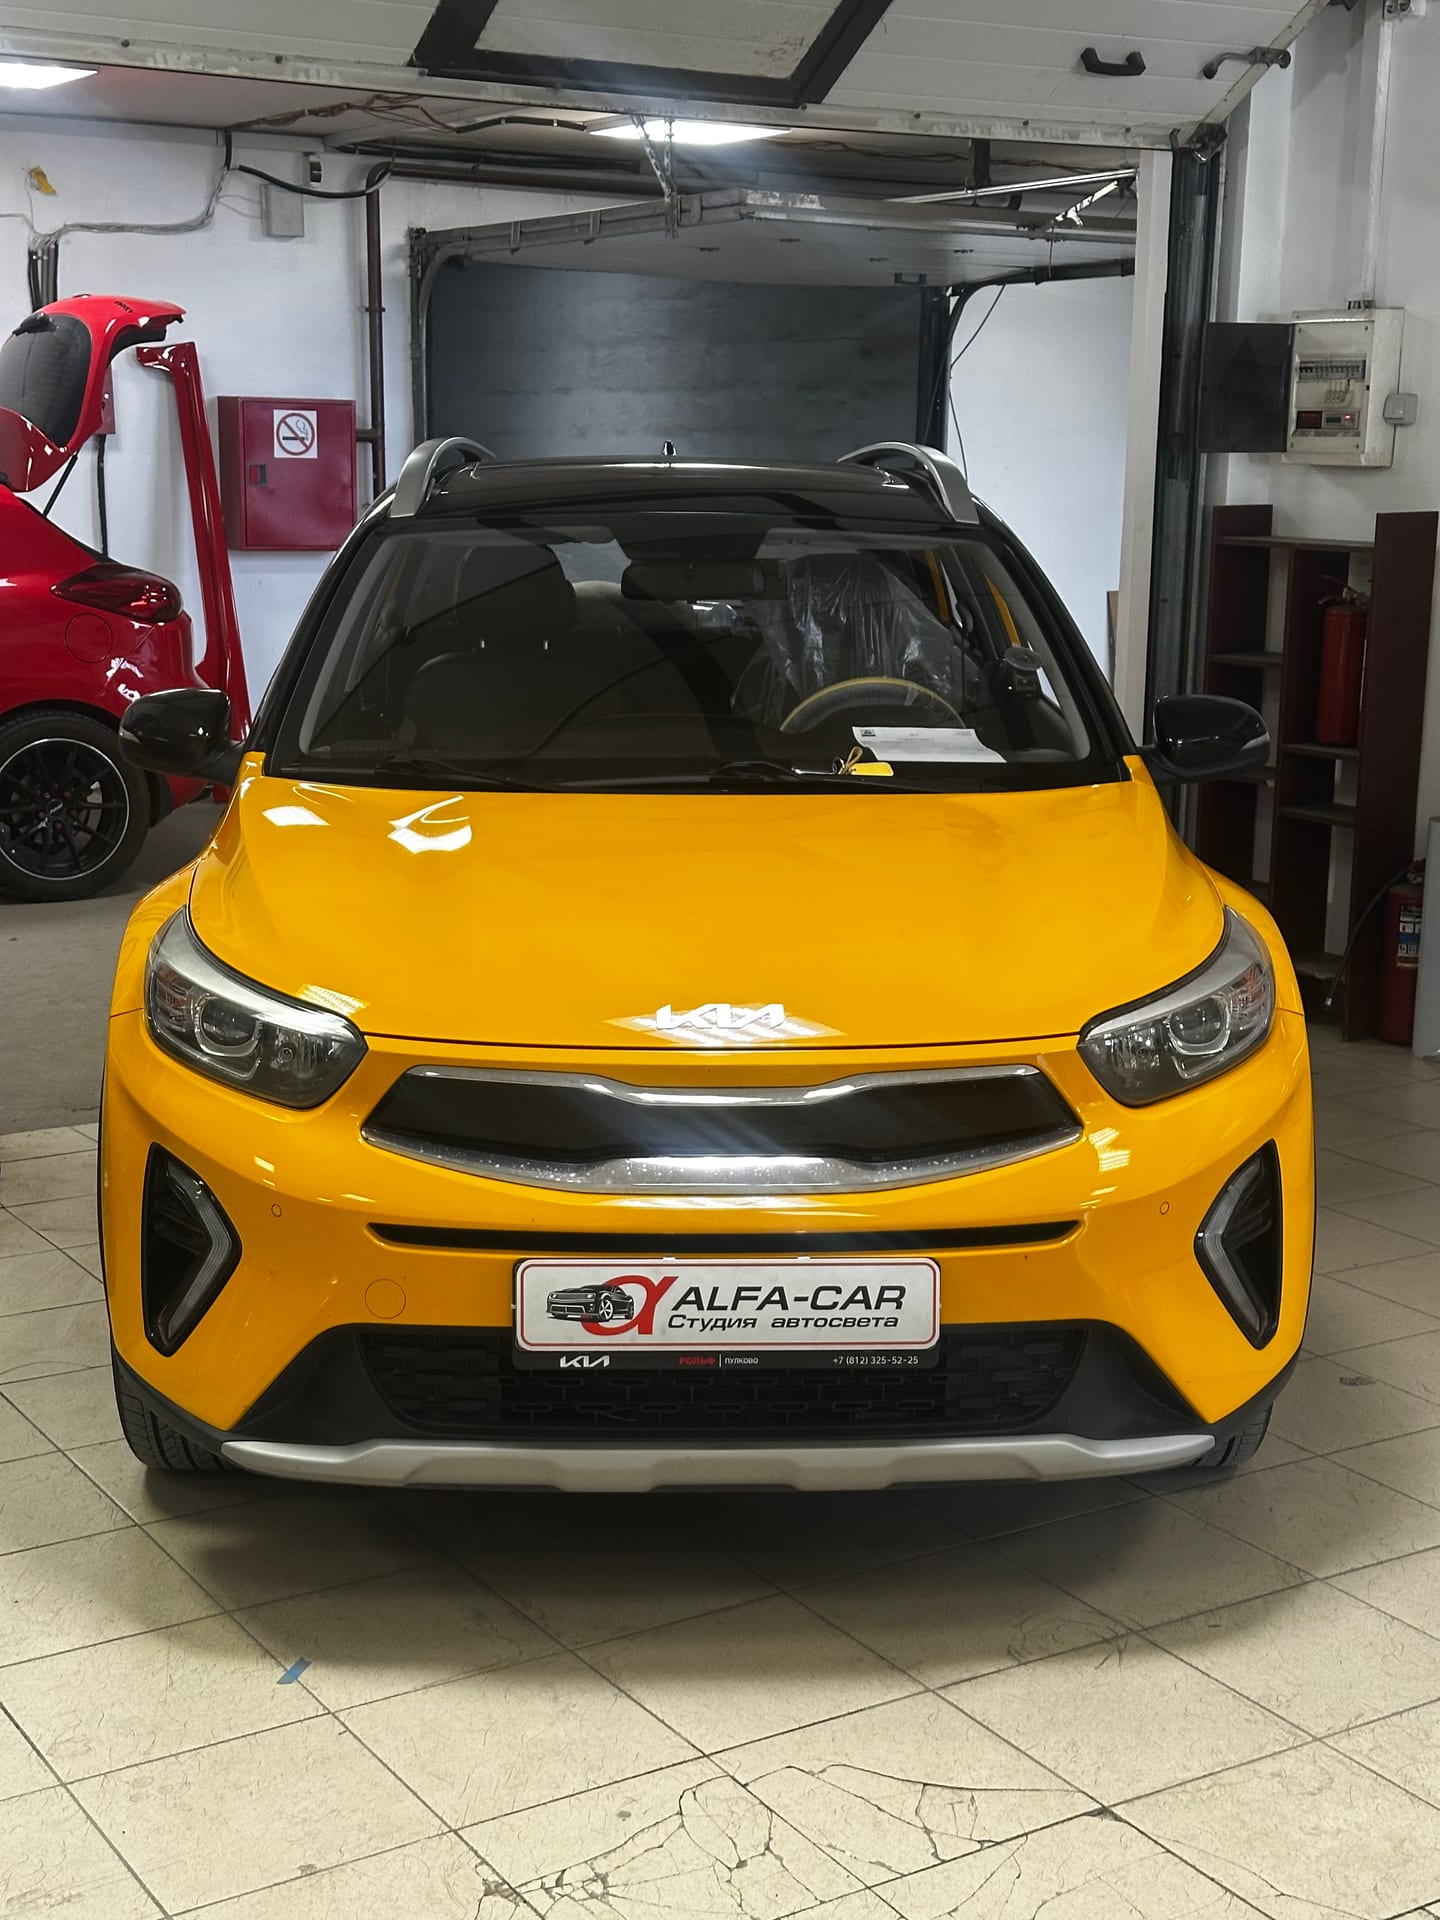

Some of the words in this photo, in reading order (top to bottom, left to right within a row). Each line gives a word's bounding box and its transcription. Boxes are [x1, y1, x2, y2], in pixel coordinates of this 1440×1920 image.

[656, 1003, 785, 1030] KIA
[671, 1285, 907, 1312] ALFA-CAR
[667, 1314, 758, 1332] Студия
[770, 1316, 900, 1329] автосвета
[559, 1355, 611, 1369] KIA
[679, 1356, 716, 1366] РОЛЬФ
[724, 1356, 760, 1366] ПУЛКОВО
[833, 1355, 844, 1365] +7
[846, 1355, 868, 1366] (812)
[870, 1355, 919, 1365] 325-52-25
